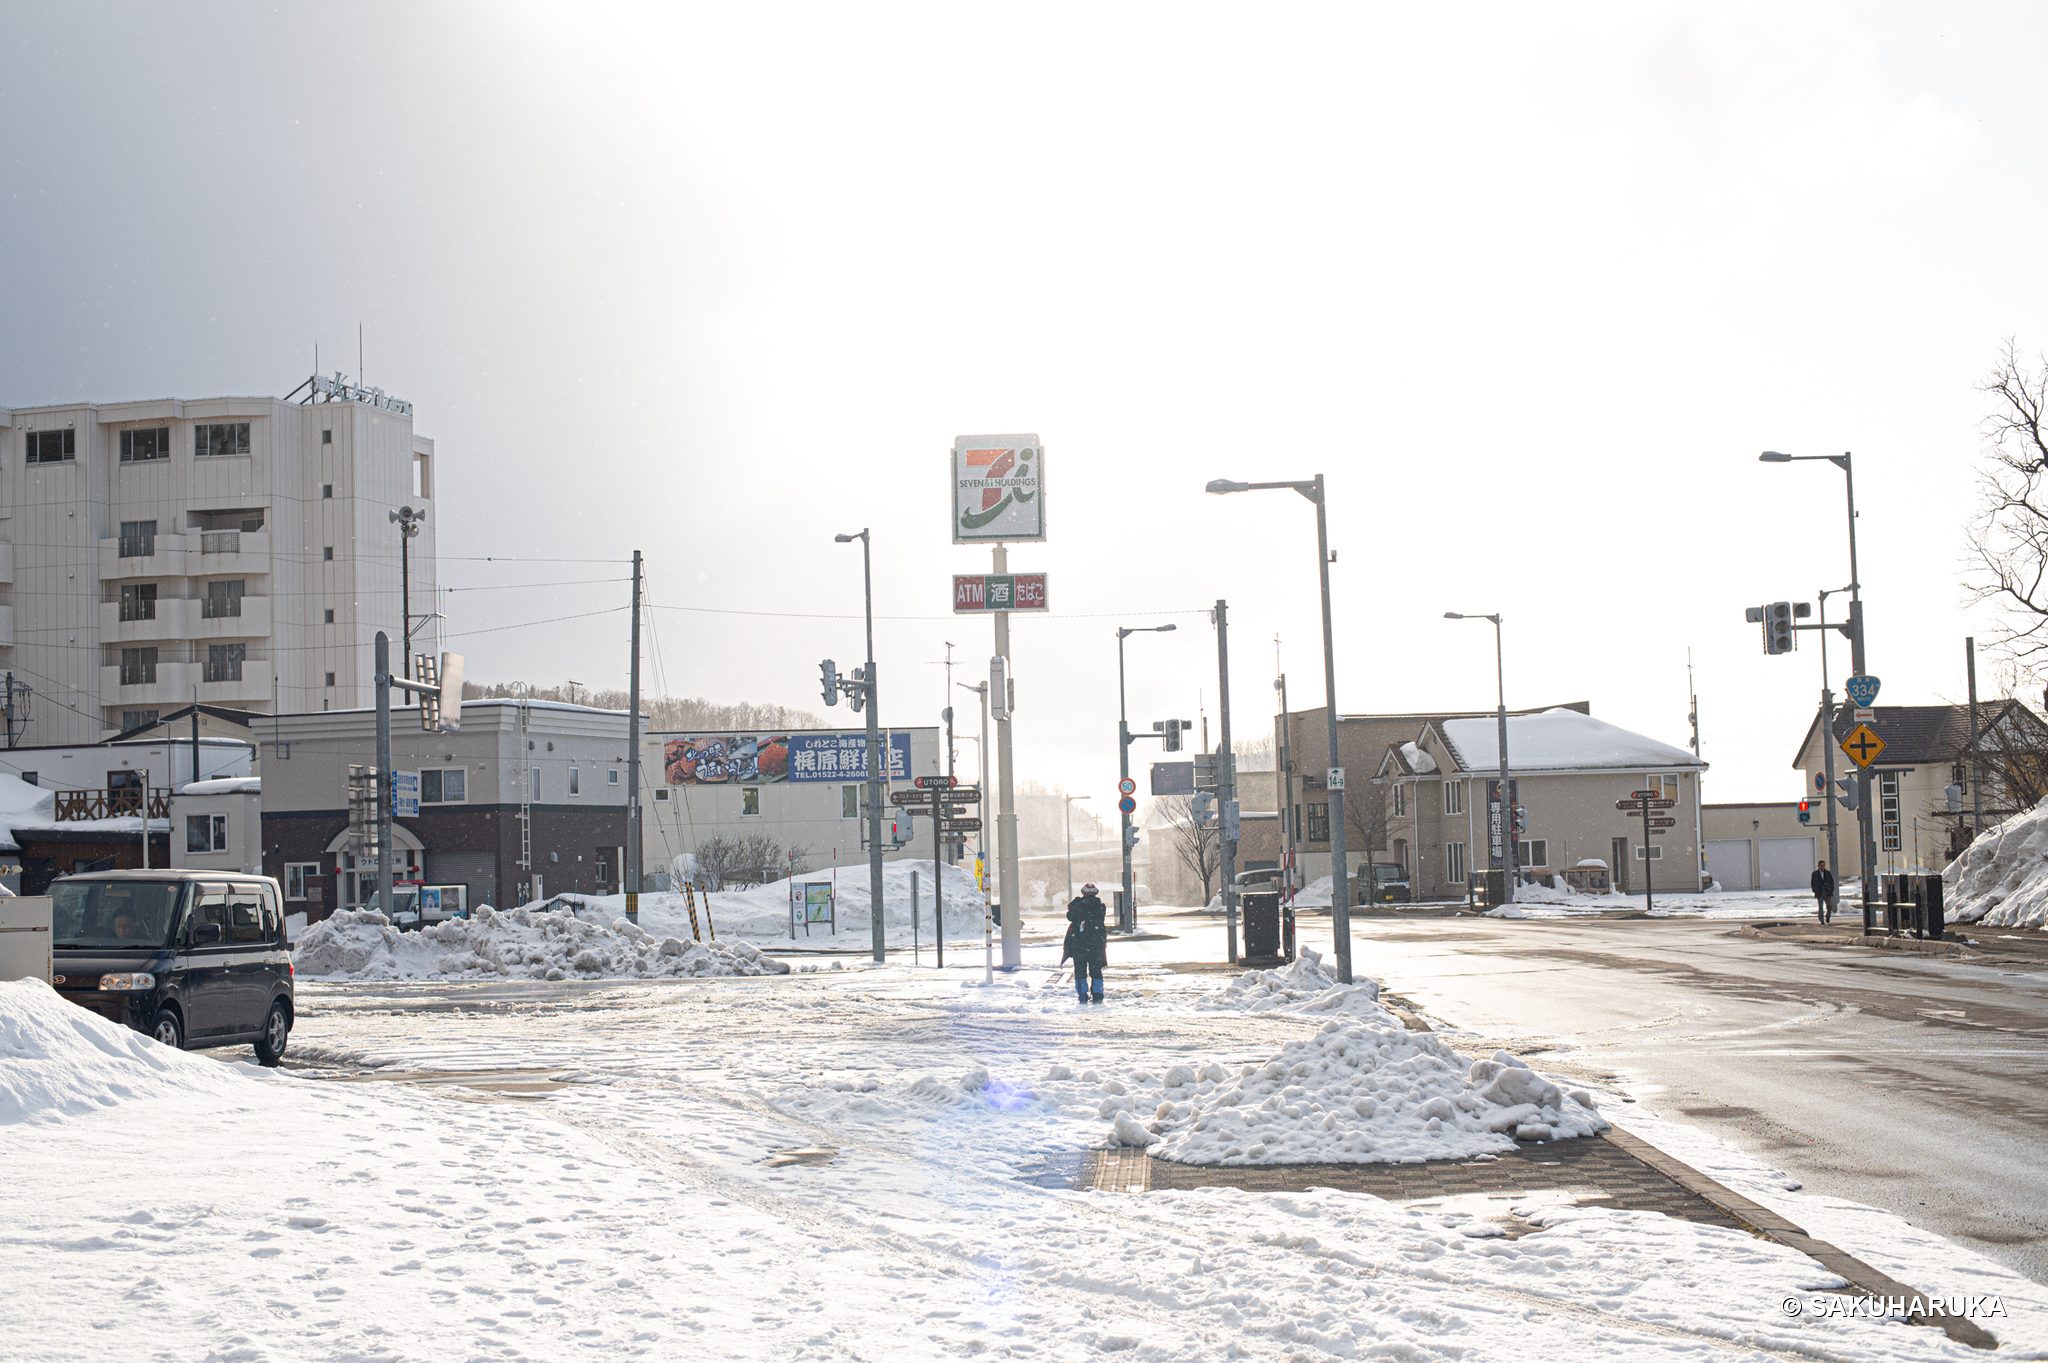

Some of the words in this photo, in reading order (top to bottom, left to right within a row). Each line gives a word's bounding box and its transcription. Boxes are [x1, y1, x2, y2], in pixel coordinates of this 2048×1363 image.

[994, 477, 1036, 487] HOLDINGS
[957, 584, 983, 603] ATM
[991, 582, 1010, 602] 酒
[1016, 582, 1044, 601] たばこ
[1852, 684, 1875, 697] 334
[805, 738, 893, 749] しれとこ海産物
[923, 778, 949, 786] UTORO
[1490, 801, 1503, 858] 専用駐車場
